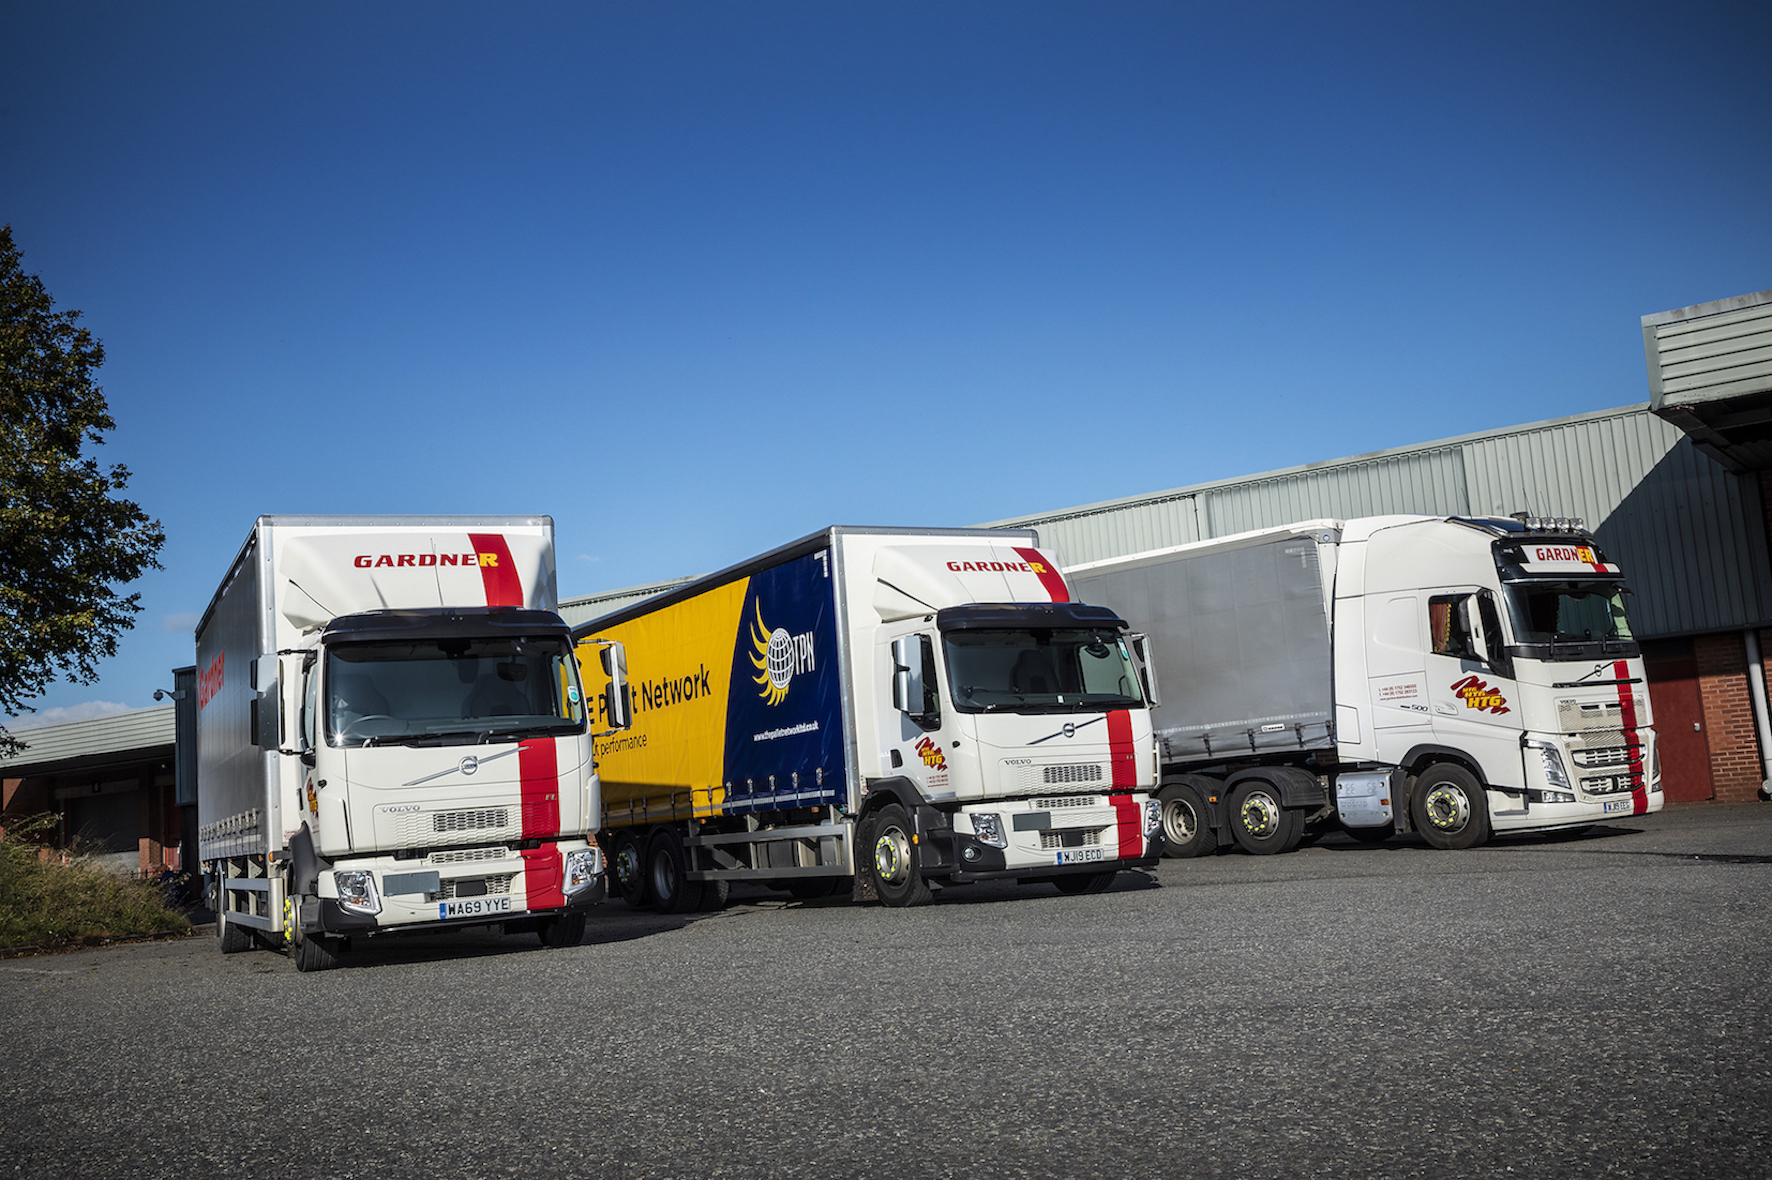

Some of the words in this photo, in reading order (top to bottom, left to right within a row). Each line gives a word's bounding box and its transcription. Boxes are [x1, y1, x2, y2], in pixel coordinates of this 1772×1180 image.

[354, 553, 499, 568] GARDNER
[1536, 548, 1595, 563] GARDNER
[946, 561, 1047, 573] GARDNER
[792, 631, 816, 675] TPN
[199, 649, 224, 710] Gardner
[642, 663, 711, 712] Network
[1464, 690, 1486, 698] HTG
[1411, 704, 1429, 712] 500
[1467, 695, 1501, 708] HTG
[600, 734, 648, 758] performance
[924, 754, 943, 766] HTG
[1004, 758, 1032, 766] VOLVO
[379, 804, 421, 814] VOLVO
[448, 901, 482, 916] WA69
[485, 898, 509, 912] YYE
